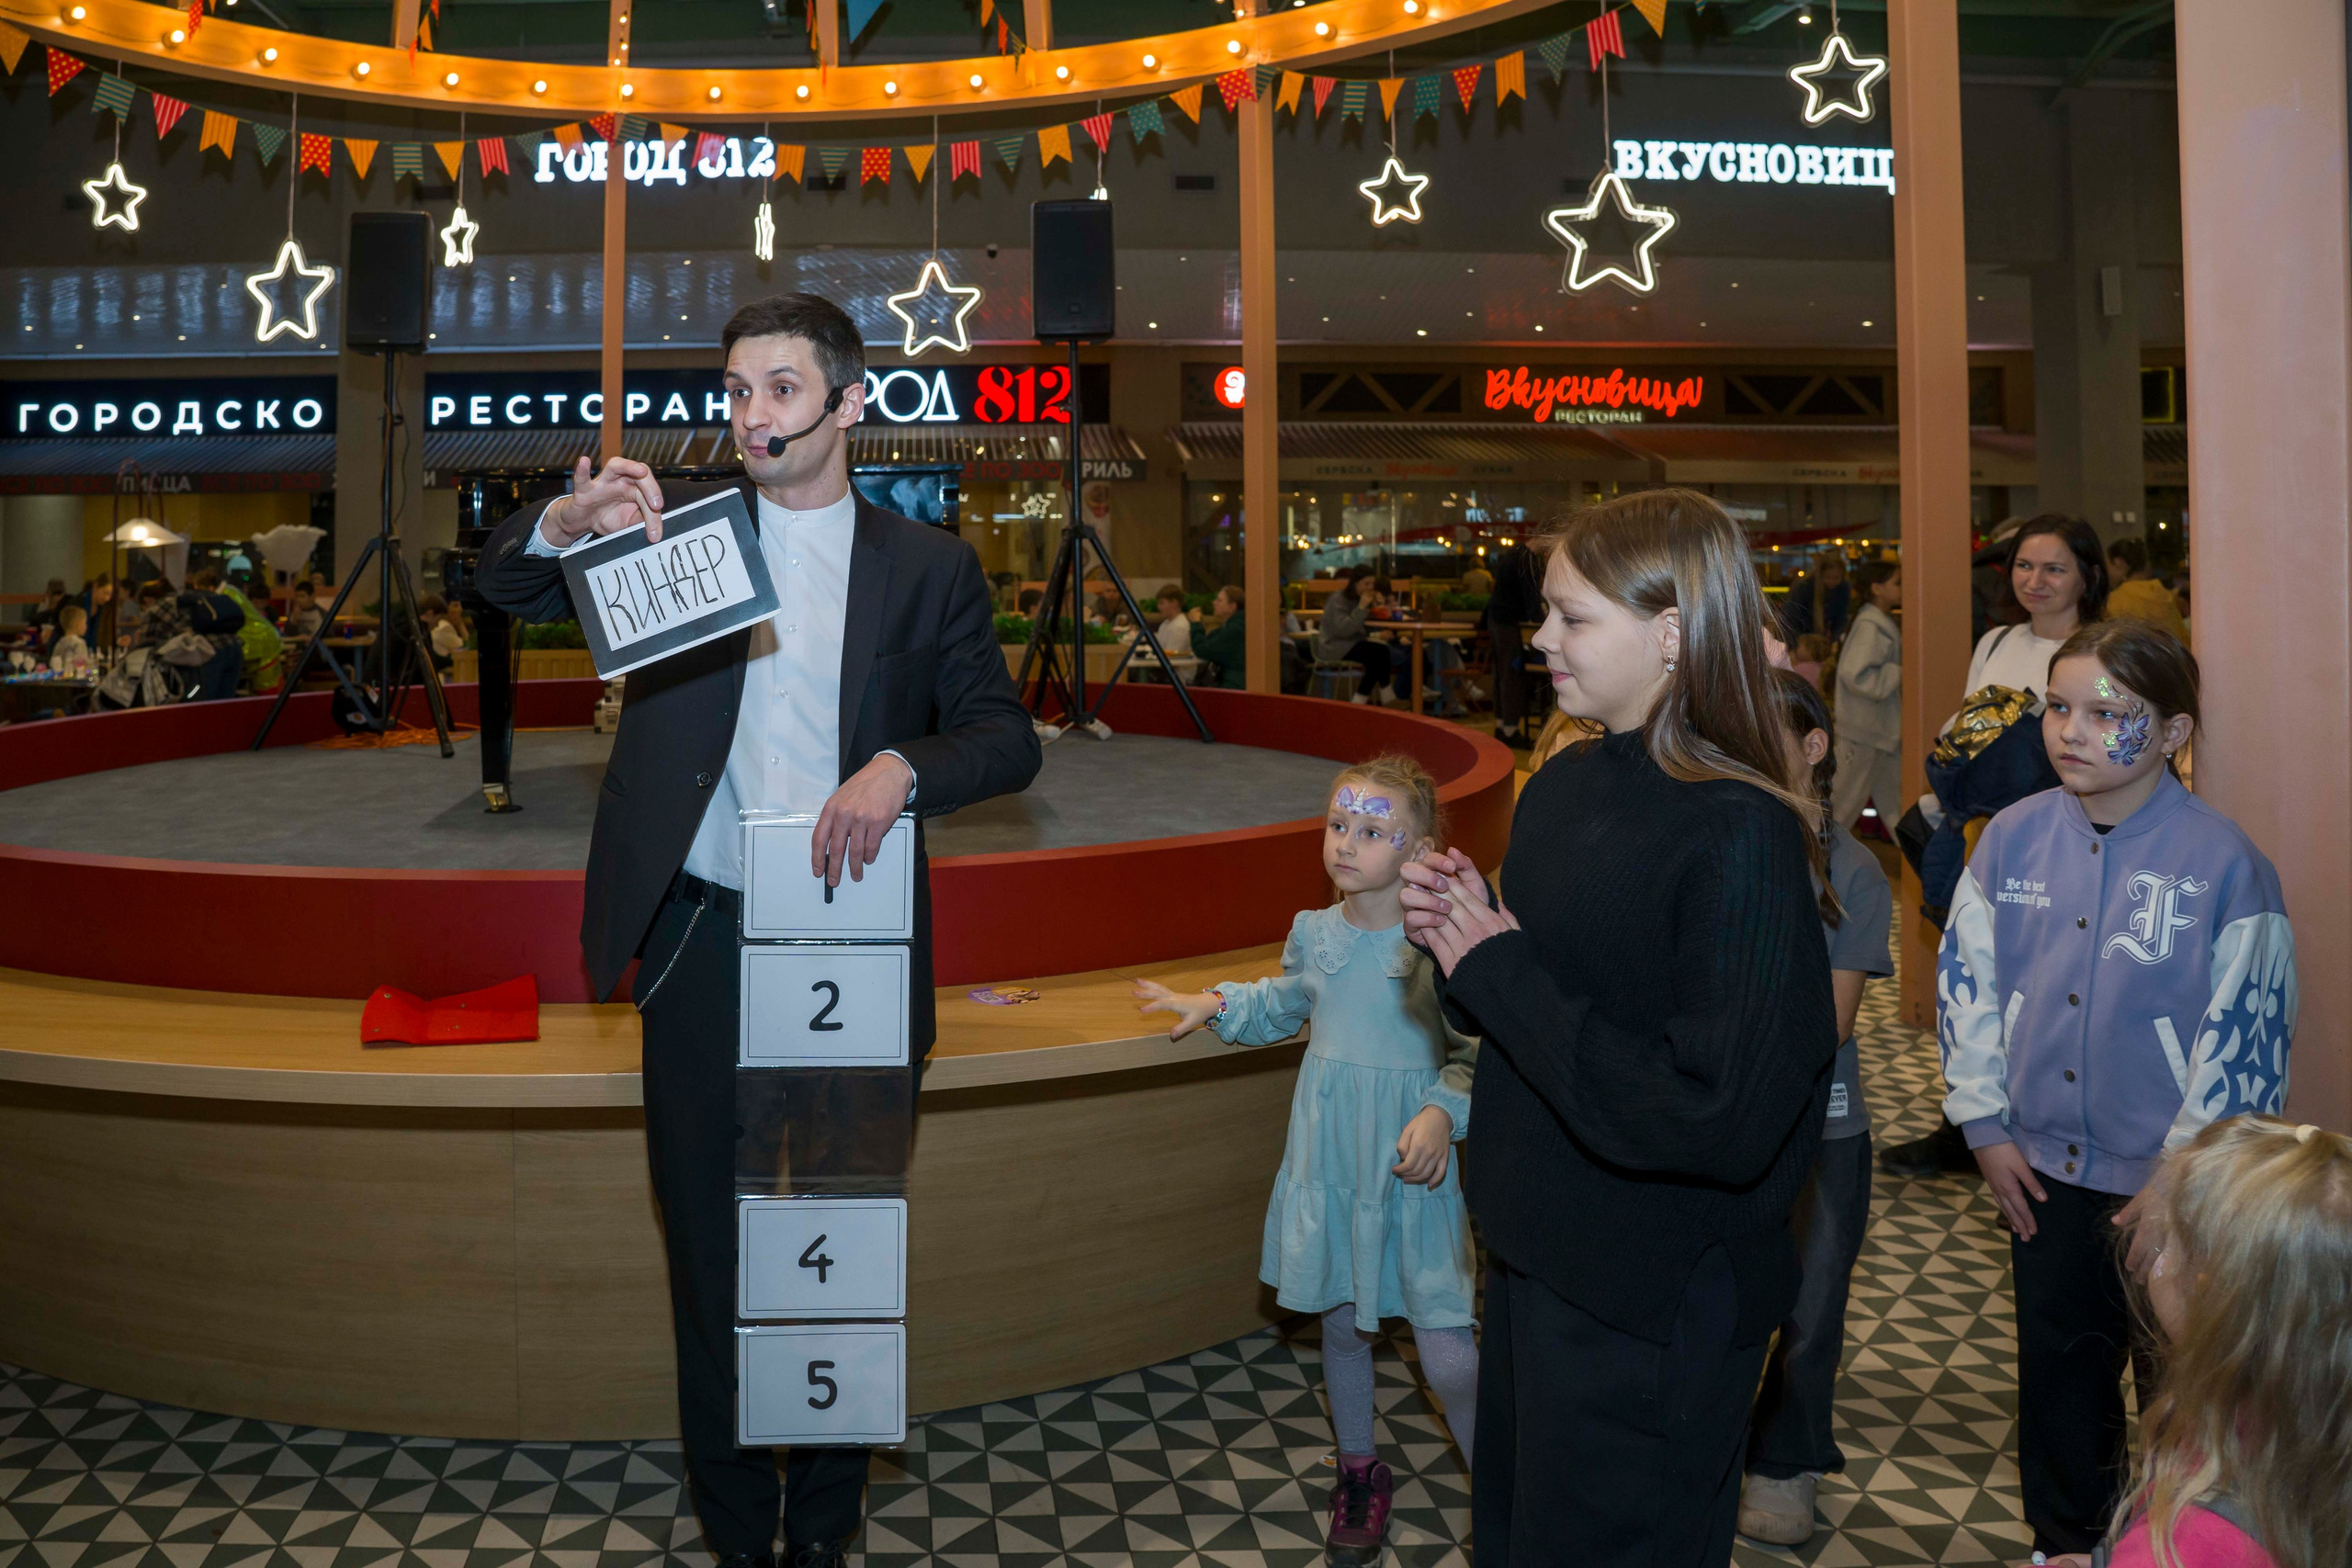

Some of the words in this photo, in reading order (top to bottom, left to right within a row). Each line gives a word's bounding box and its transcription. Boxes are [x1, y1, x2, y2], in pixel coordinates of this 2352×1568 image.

[1613, 140, 1895, 196] ВКУСНОВИЦ
[18, 399, 323, 435] ГОРОДСКО
[858, 368, 960, 423] РОД
[974, 366, 1072, 424] 812
[1081, 462, 1134, 479] РИЛЬ
[597, 534, 726, 642] КИНДЕР
[2005, 876, 2022, 891] Be
[808, 980, 843, 1032] 2
[798, 1234, 834, 1284] 4
[808, 1359, 838, 1410] 5
